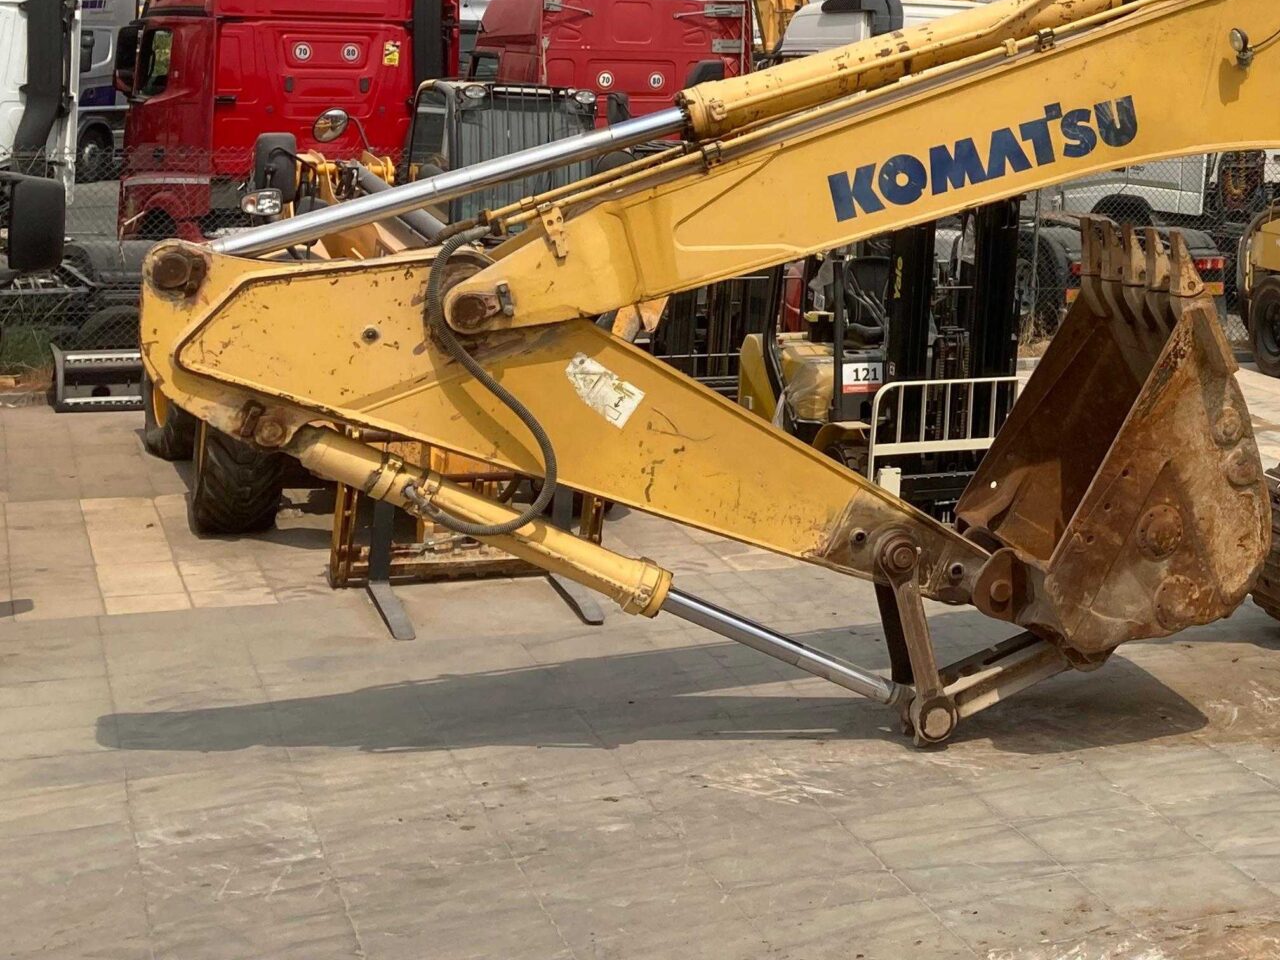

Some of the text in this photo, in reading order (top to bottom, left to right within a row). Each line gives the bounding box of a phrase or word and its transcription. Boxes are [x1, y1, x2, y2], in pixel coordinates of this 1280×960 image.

[298, 48, 308, 56] 70
[346, 49, 356, 57] 80
[601, 76, 611, 84] 70
[652, 77, 661, 85] 80
[827, 95, 1138, 222] KOMATSU
[893, 256, 903, 299] Yale
[853, 368, 879, 381] 121
